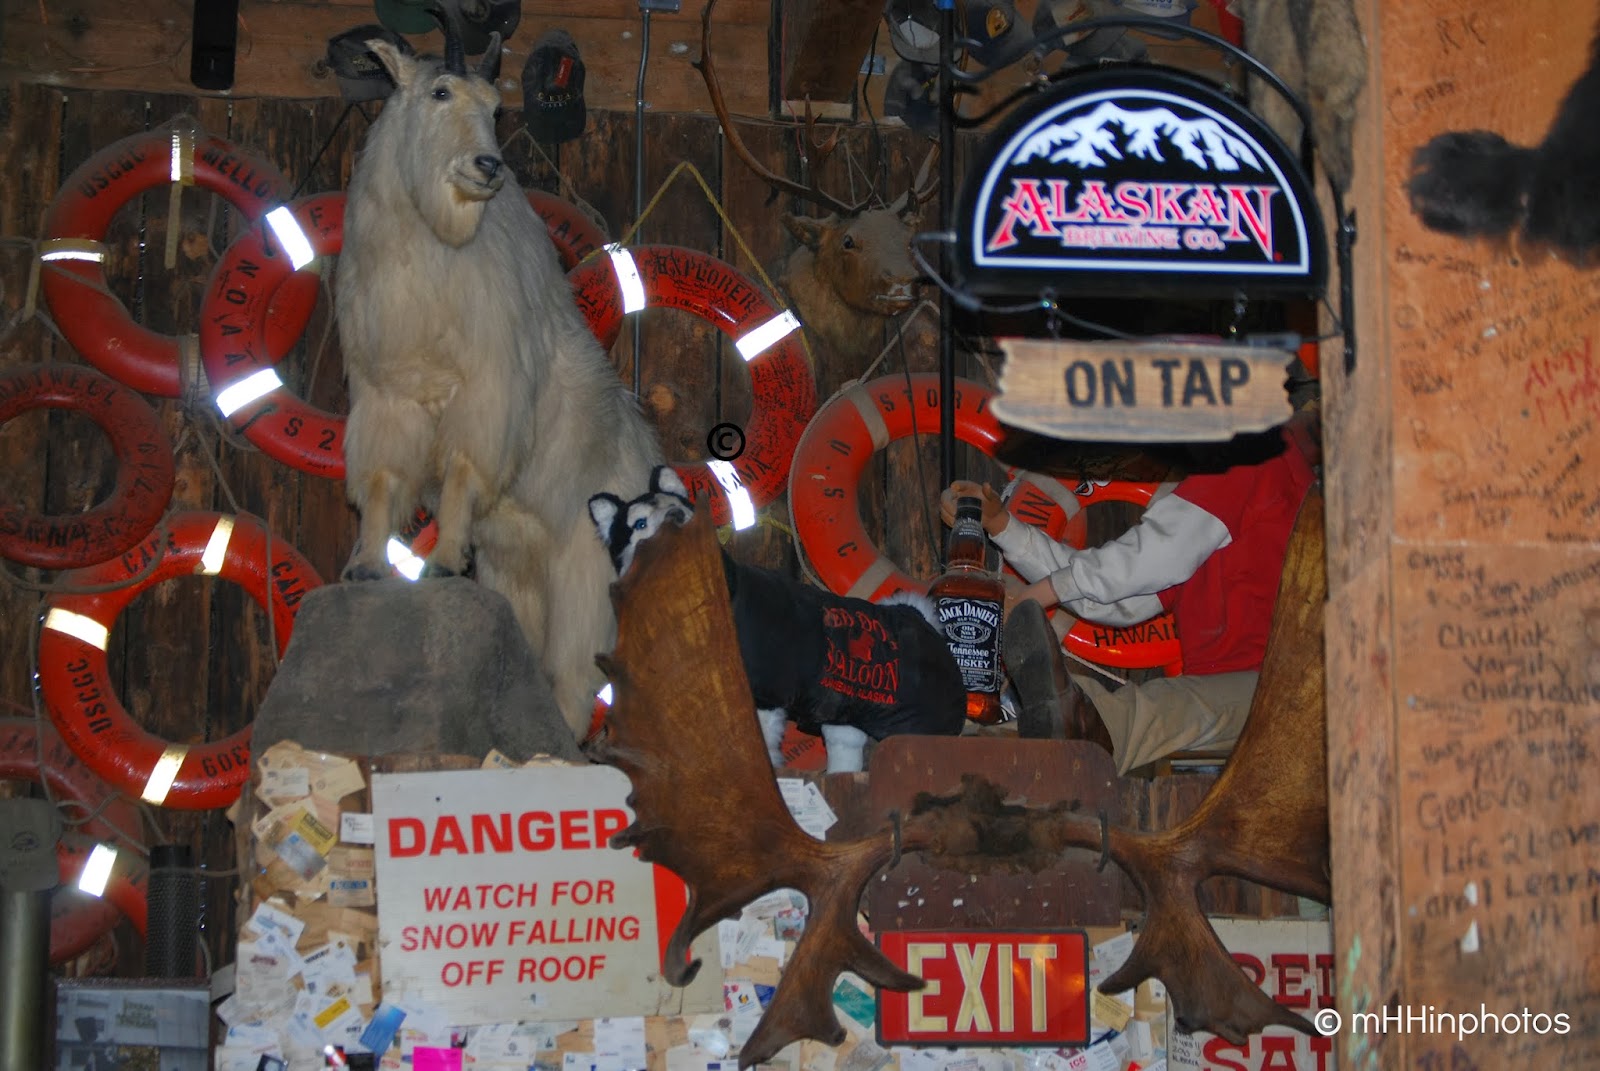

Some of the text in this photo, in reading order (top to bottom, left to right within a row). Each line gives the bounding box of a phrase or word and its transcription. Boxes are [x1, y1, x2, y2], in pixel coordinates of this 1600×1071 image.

[986, 178, 1281, 262] ALASKAN
[1062, 226, 1226, 250] BREWING CO.
[1064, 358, 1250, 408] ON TAP
[271, 561, 305, 618] CAR
[940, 605, 963, 622] JACK
[823, 637, 899, 692] SALOON
[947, 642, 990, 657] Tennessee
[956, 658, 990, 669] ISKEY
[67, 658, 113, 734] USCGC
[424, 880, 615, 912] WATCH FOR
[401, 916, 640, 951] SNOW FALLING
[441, 956, 606, 987] OFF ROOF
[906, 942, 1058, 1033] EXIT
